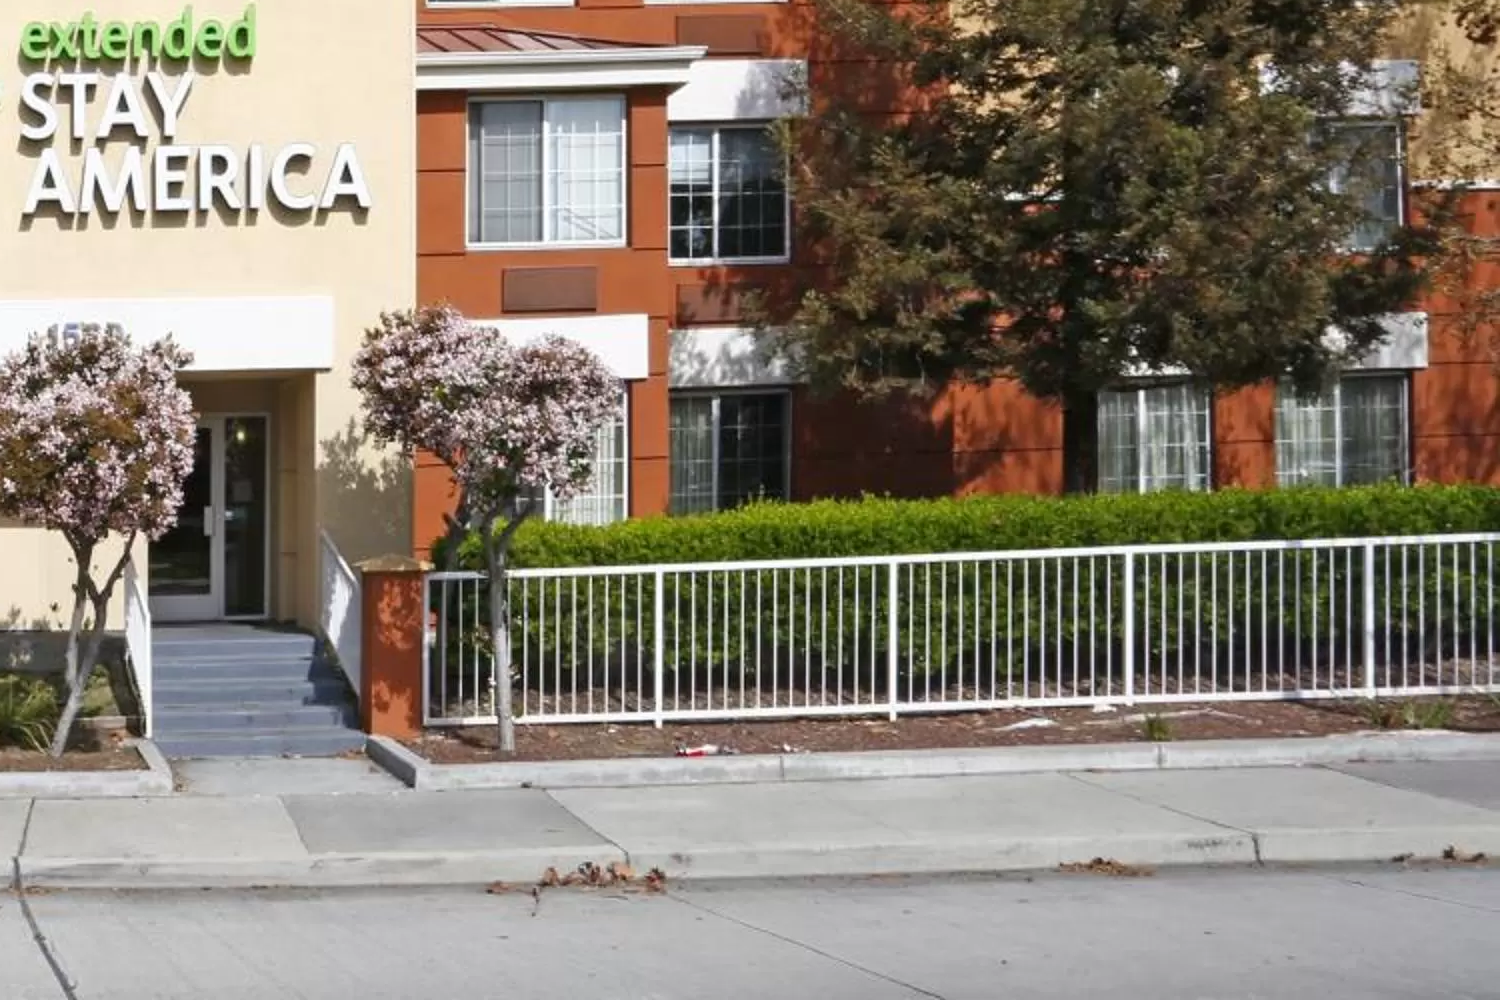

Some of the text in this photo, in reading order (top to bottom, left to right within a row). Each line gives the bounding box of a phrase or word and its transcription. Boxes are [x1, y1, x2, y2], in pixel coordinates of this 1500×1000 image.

[20, 3, 256, 59] extended
[21, 72, 194, 139] STAY
[23, 143, 372, 213] AMERICA
